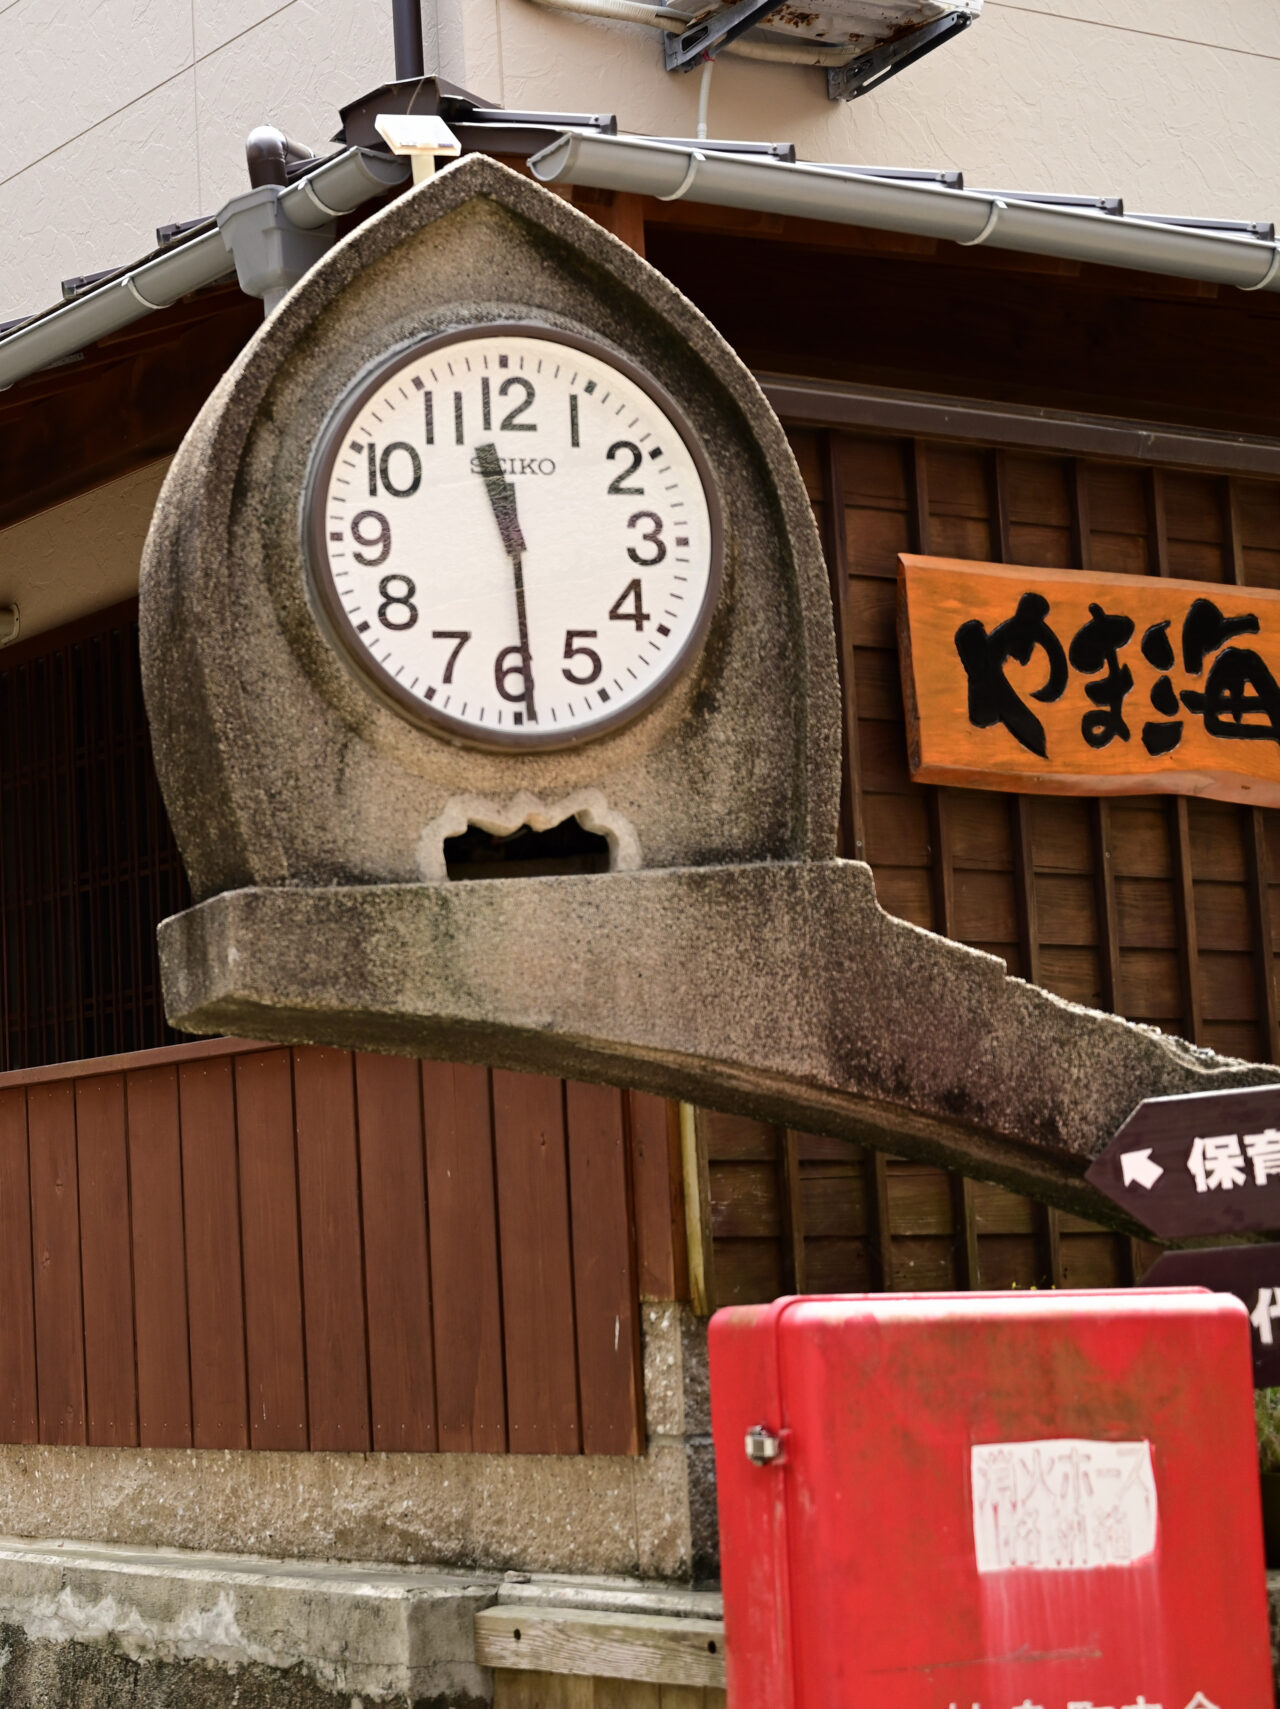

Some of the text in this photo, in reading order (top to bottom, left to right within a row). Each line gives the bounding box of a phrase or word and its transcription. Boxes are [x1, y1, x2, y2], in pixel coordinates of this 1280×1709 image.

[424, 391, 464, 445] 11
[481, 376, 538, 432] 12
[568, 394, 580, 448] 1
[367, 442, 422, 498] 10
[605, 440, 645, 496] 2
[350, 510, 392, 567] 9
[626, 510, 666, 566] 3
[377, 573, 419, 631] 8
[608, 578, 651, 633] 4
[431, 630, 471, 684] 7
[494, 645, 534, 703] 6
[561, 630, 603, 685] 5
